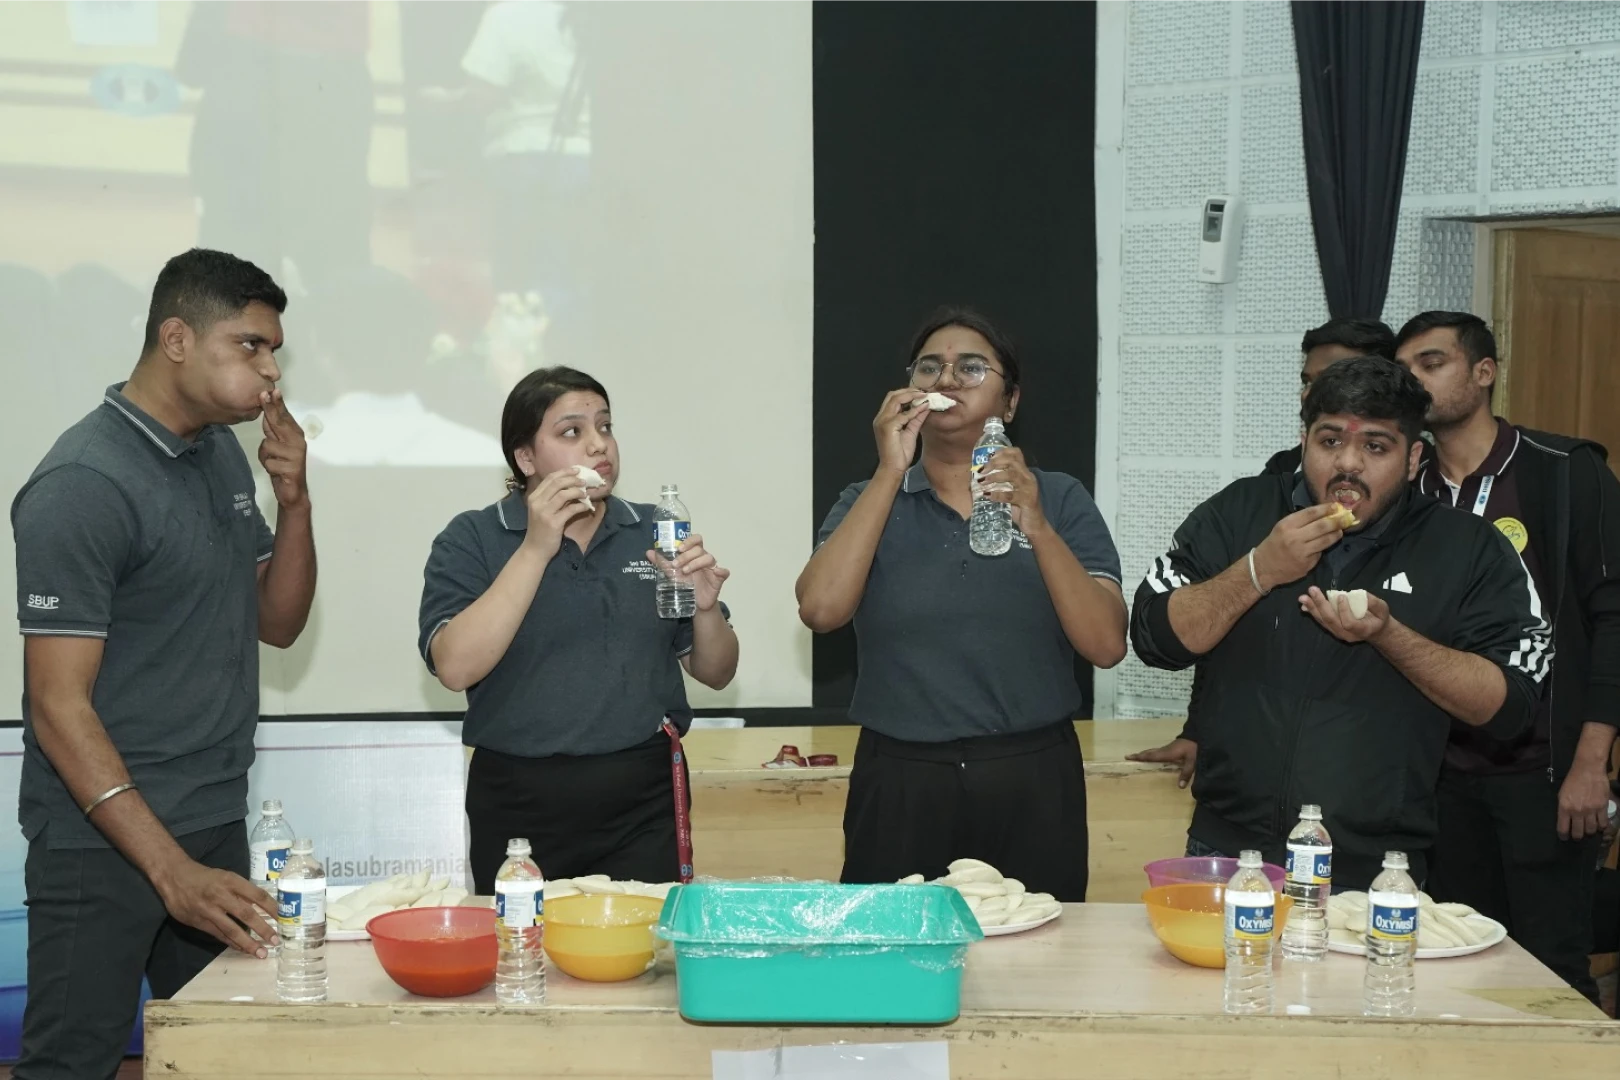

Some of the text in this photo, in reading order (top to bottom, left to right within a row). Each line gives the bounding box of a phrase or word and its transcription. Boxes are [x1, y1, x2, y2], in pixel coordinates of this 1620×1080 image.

[28, 593, 60, 608] SBUP
[1238, 914, 1274, 929] OXYMIST
[1375, 914, 1415, 930] OXYMIST
